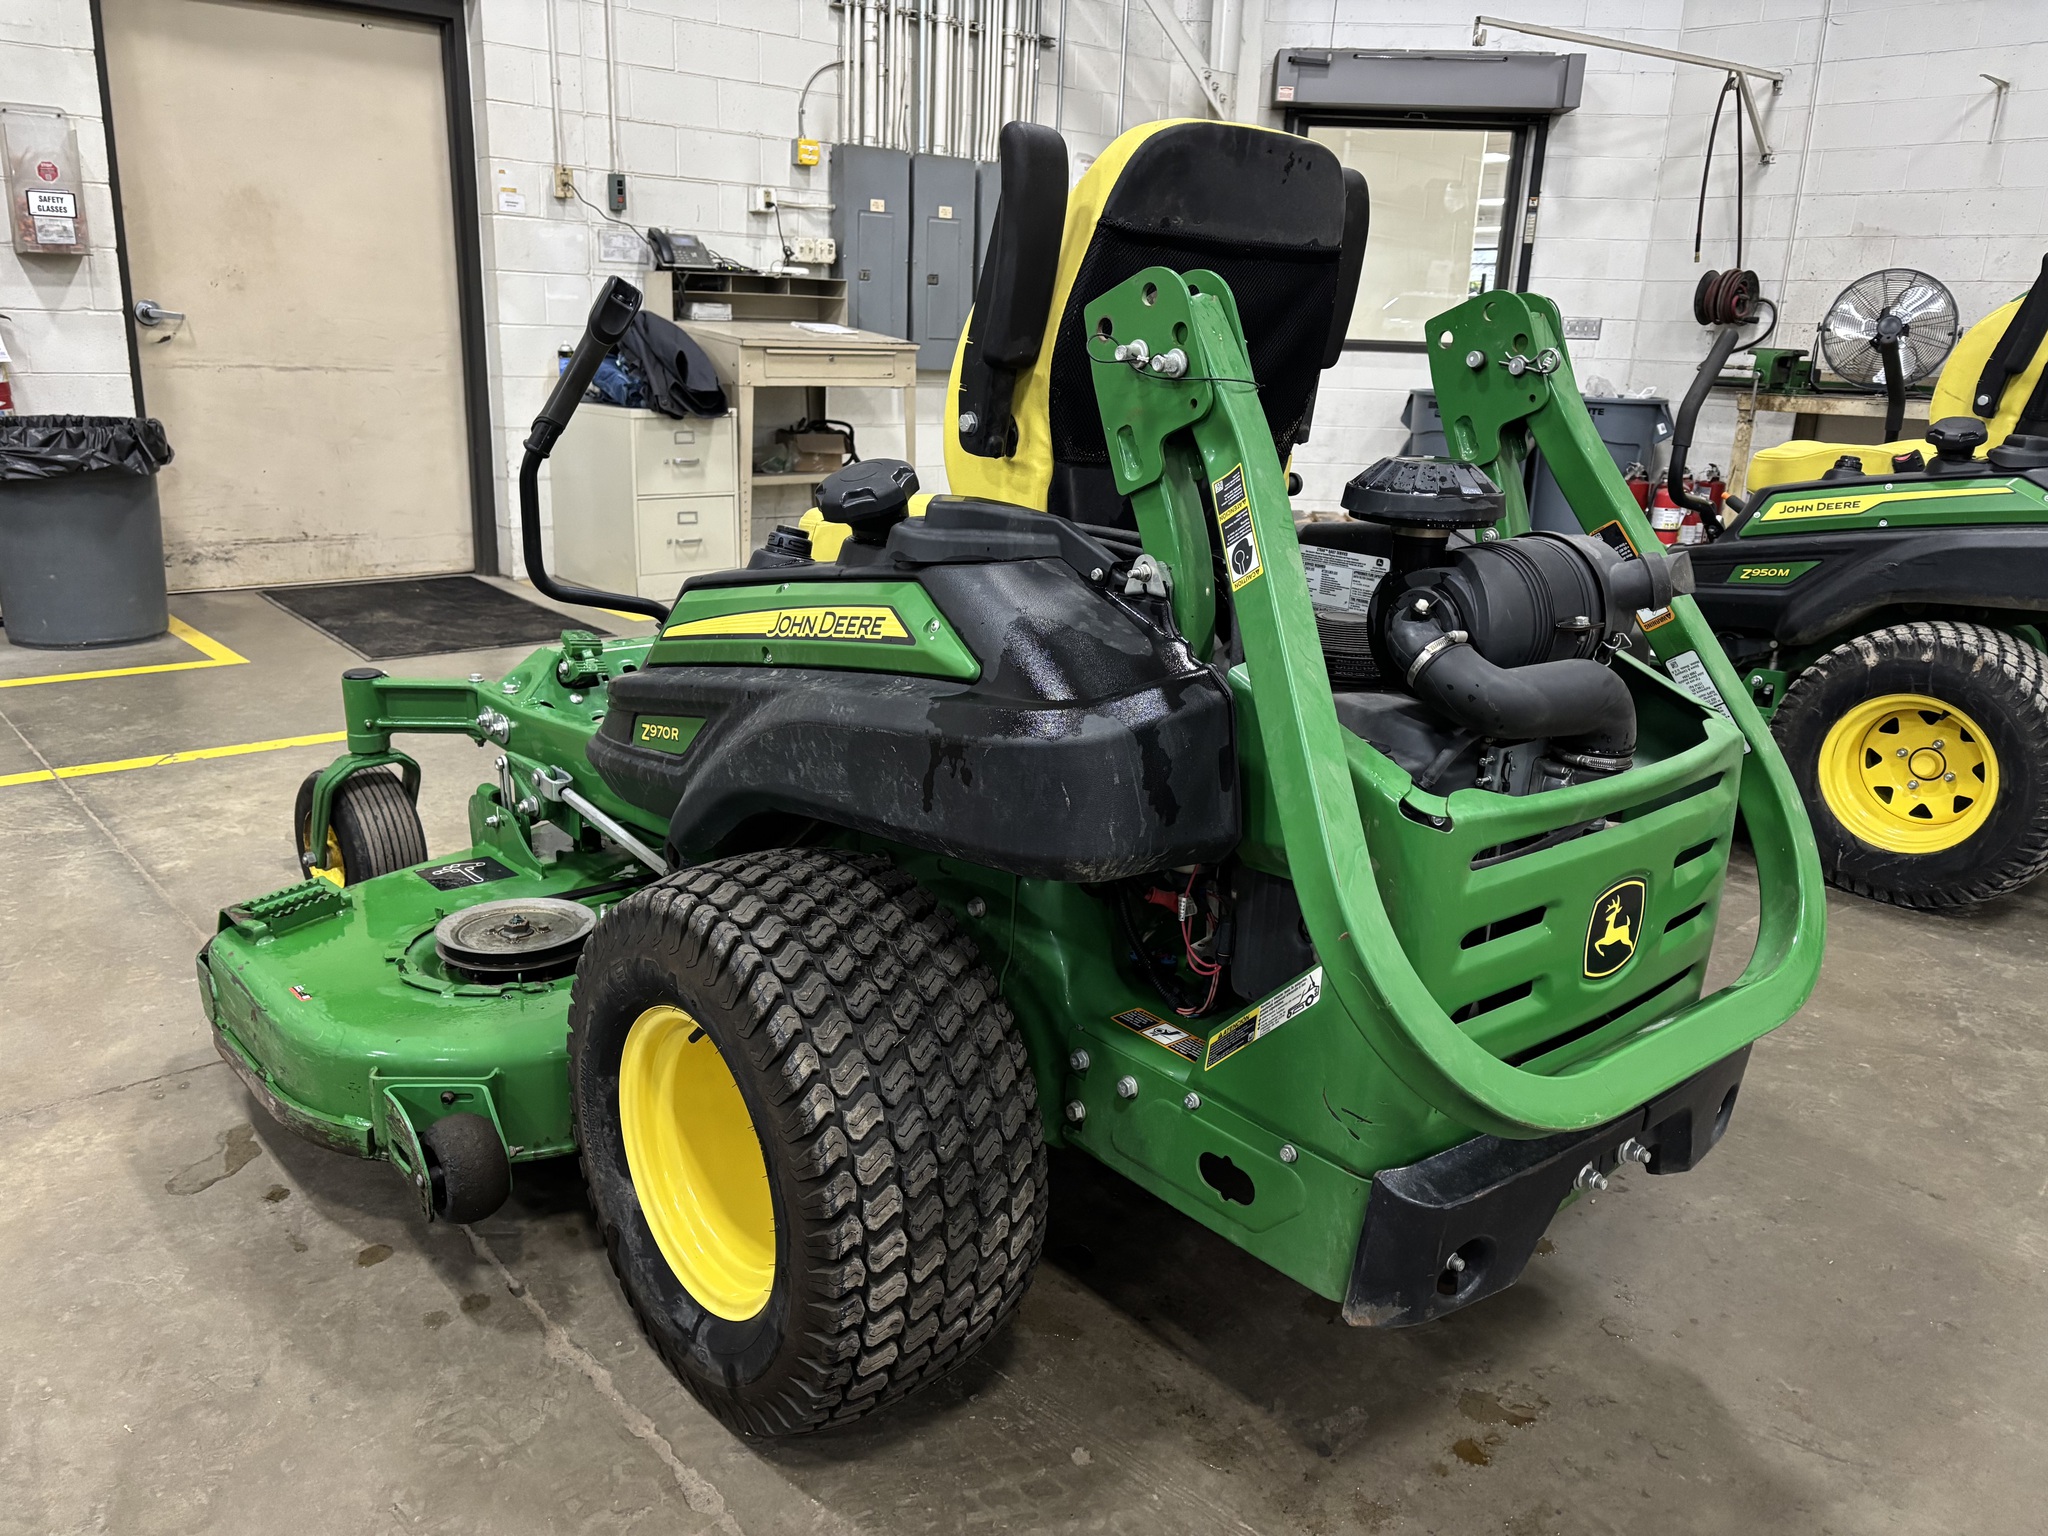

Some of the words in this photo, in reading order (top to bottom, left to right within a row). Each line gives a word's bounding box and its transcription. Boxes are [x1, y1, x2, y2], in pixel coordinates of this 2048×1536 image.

[39, 195, 64, 203] SAFETY
[37, 205, 68, 213] GLASSES
[1779, 504, 1814, 514] JOHN
[1816, 500, 1861, 511] DEERE
[1234, 571, 1256, 590] CAUTION
[1740, 568, 1790, 580] Z950M
[767, 612, 818, 635] JOHN
[819, 611, 886, 636] DEERE
[641, 723, 680, 742] Z970R
[1223, 1014, 1251, 1038] ATENCIÓN
